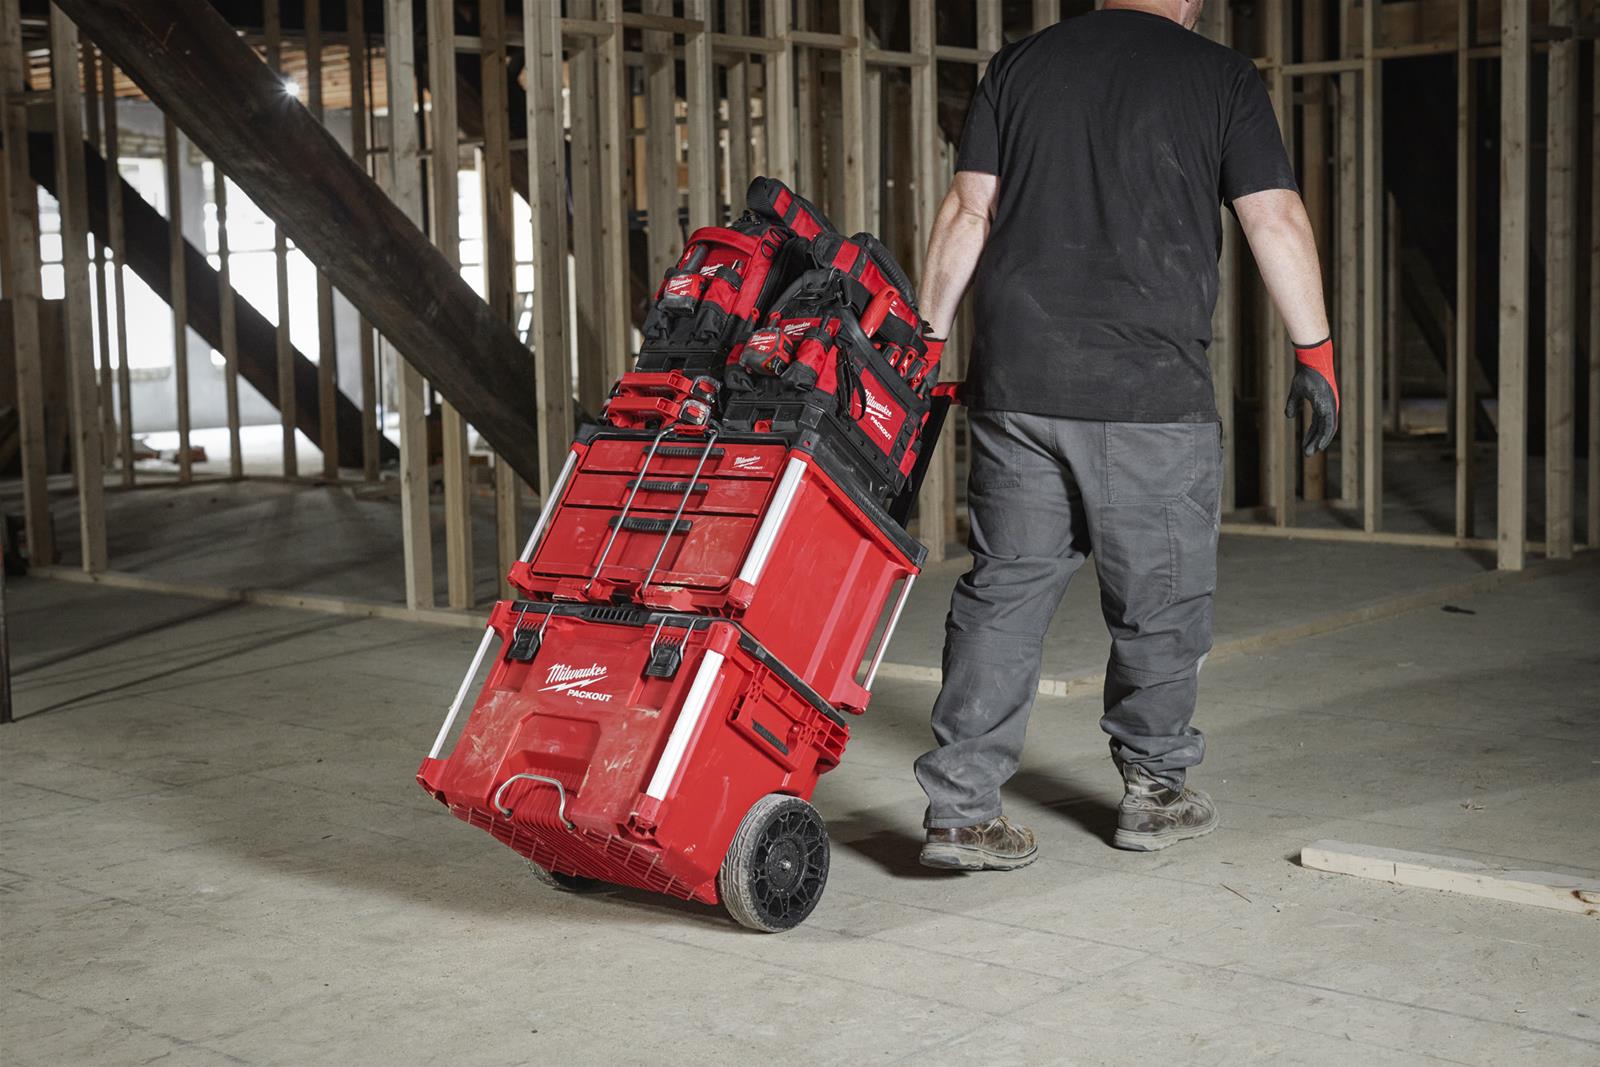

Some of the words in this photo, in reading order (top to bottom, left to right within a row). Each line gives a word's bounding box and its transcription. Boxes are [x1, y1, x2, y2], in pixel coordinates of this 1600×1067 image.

[865, 389, 893, 418] Milwaukee
[870, 415, 893, 440] PACKOUT
[734, 456, 761, 466] Milwaukee
[545, 662, 608, 685] Milwaukee
[566, 688, 613, 702] PACKOUT
